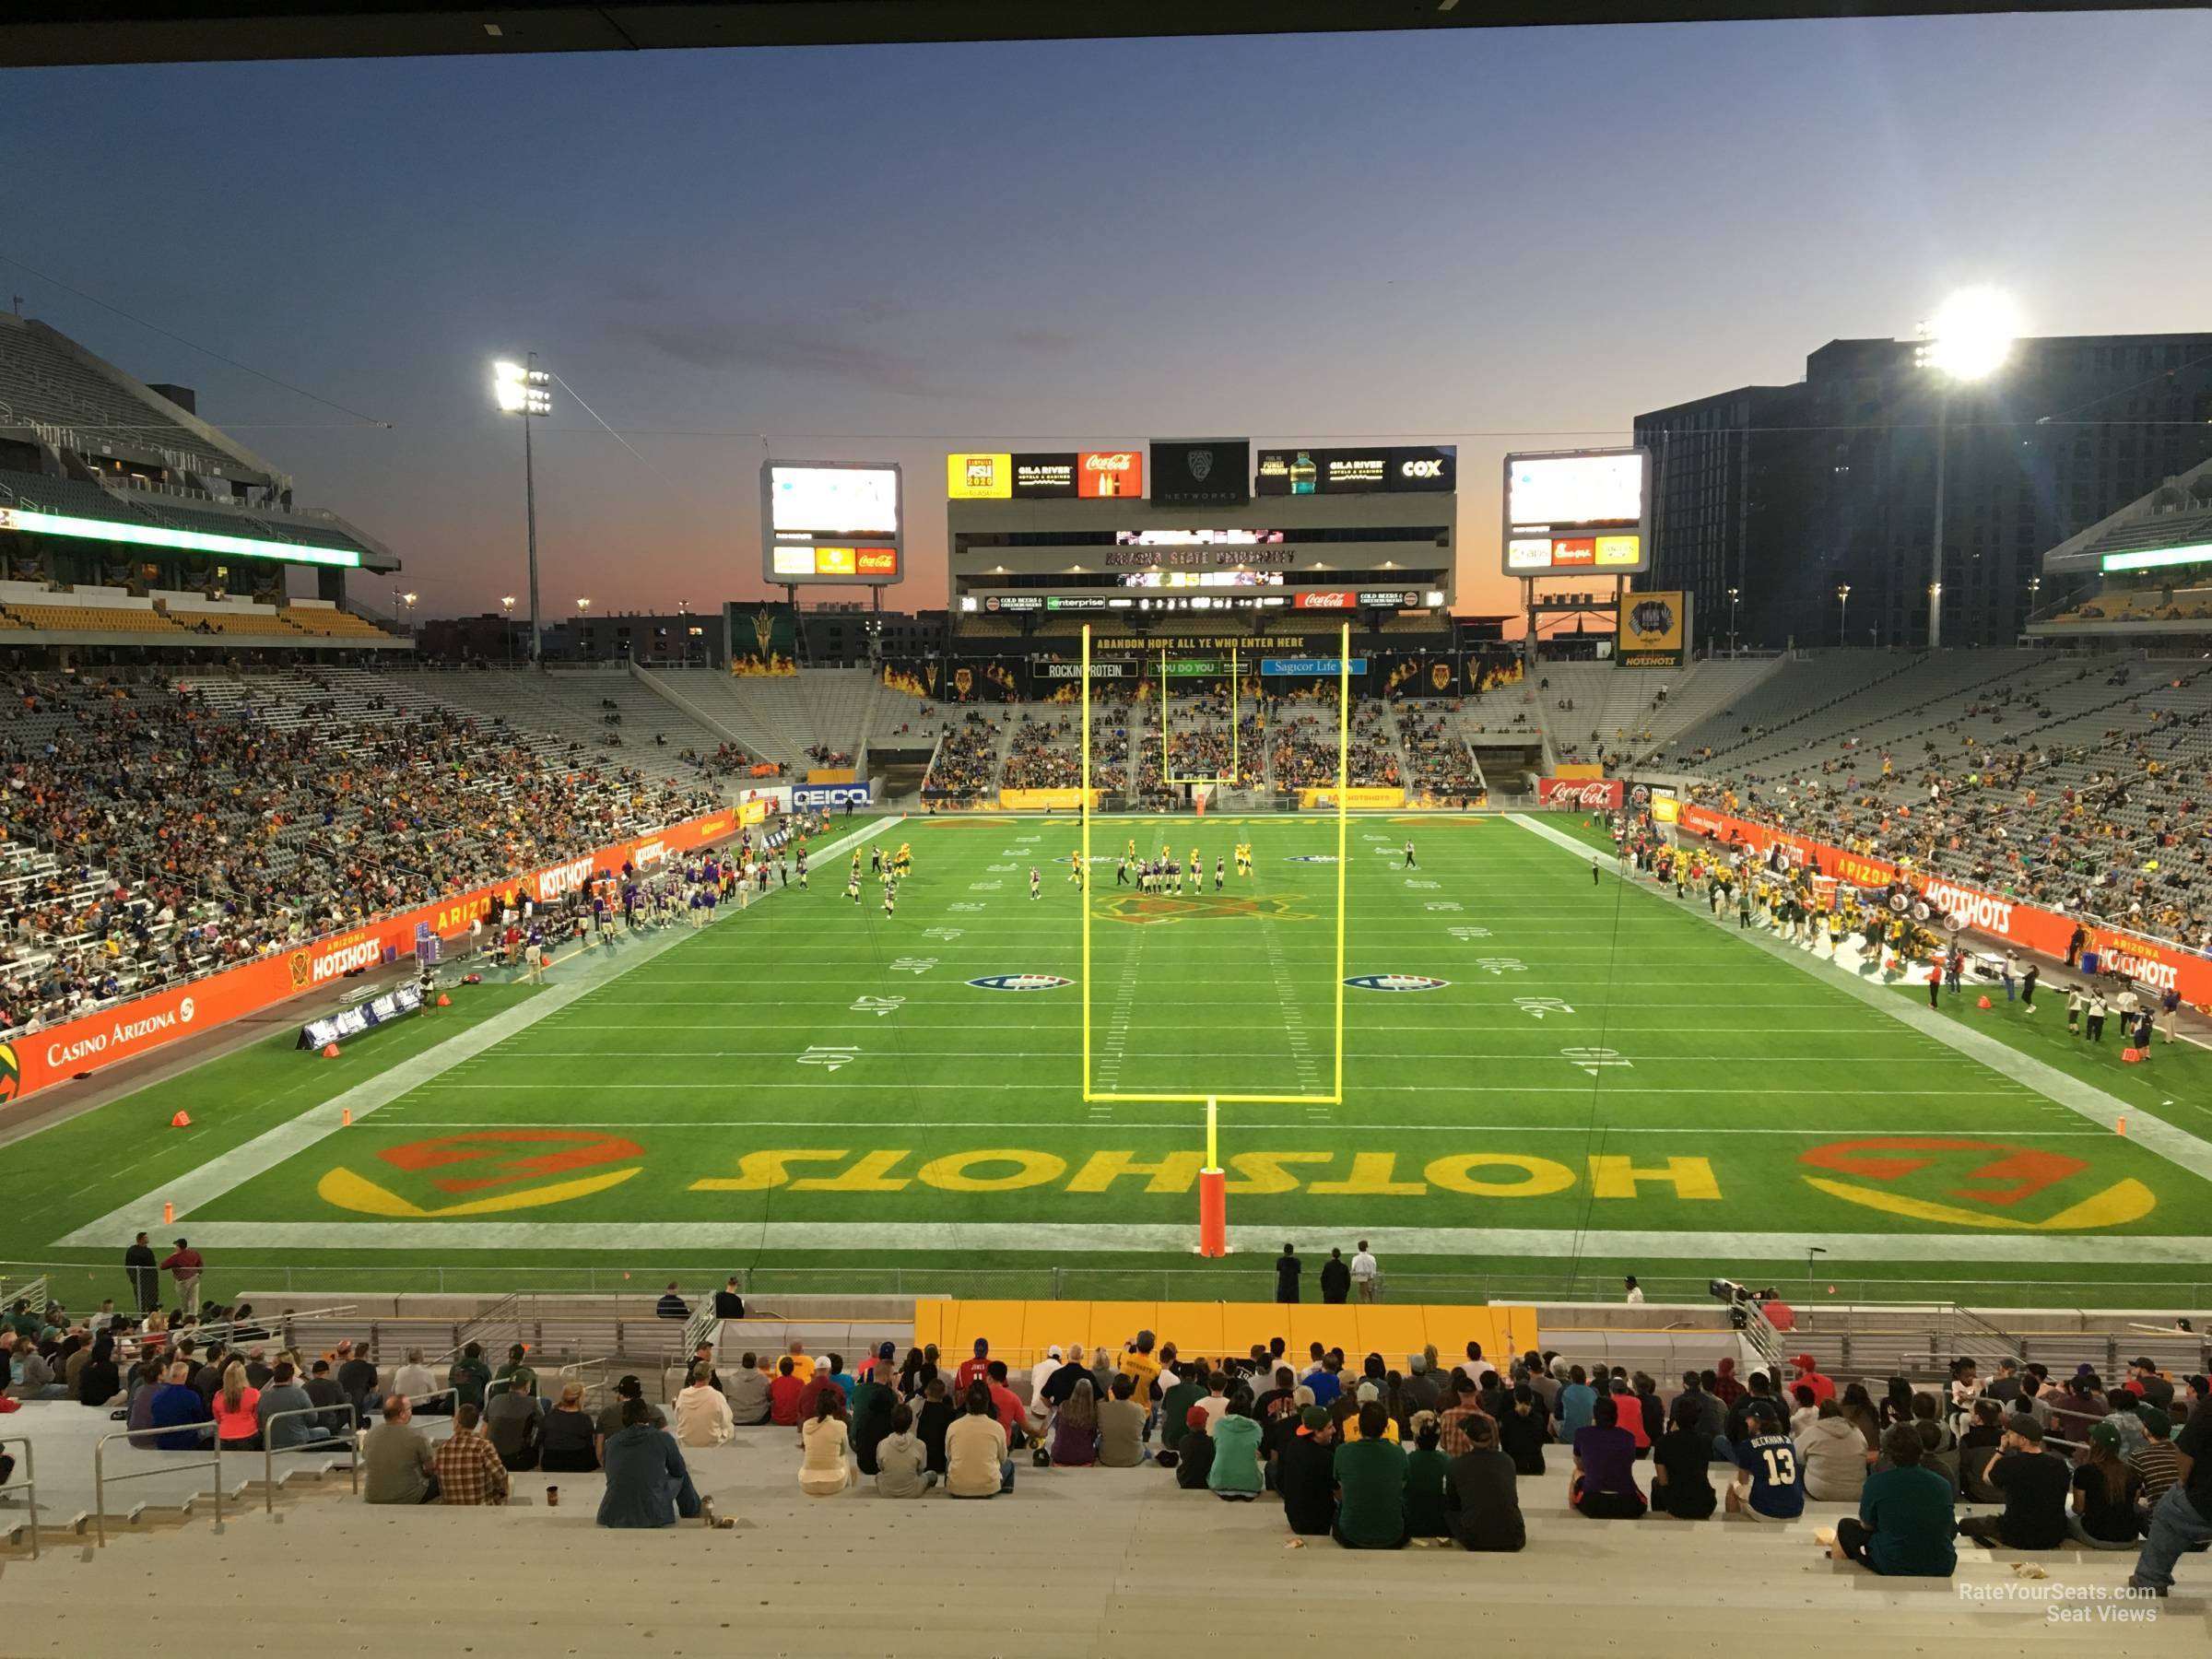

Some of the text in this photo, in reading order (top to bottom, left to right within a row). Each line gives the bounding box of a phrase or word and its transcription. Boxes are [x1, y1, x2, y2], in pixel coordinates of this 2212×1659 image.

[1086, 454, 1133, 470] Coca-Cola
[1330, 461, 1353, 469] GILA
[1402, 459, 1443, 477] COX
[968, 465, 992, 477] ASU
[1018, 465, 1070, 475] GILA RIVER
[968, 477, 993, 486] 2020
[859, 555, 893, 568] Coca-Cola
[1170, 552, 1209, 565] STATE
[1052, 599, 1104, 608] enterprise
[1305, 593, 1346, 607] Coca-Cola
[1097, 637, 1304, 649] ABANDON HOPE ALL YE WHO ENTER HERE
[1156, 663, 1215, 673] YOU DO YOU
[1275, 660, 1336, 674] Sagicor Life
[1626, 657, 1676, 666] HOTSHOTS
[1087, 664, 1123, 677] ROTEIN
[794, 788, 869, 806] GEICO
[1551, 782, 1614, 805] Coca-Cola
[1039, 818, 1364, 827] HOTSHOTS
[1837, 858, 1892, 886] ARIZON
[437, 888, 514, 931] ARIZOA
[1924, 880, 2013, 935] HOTSHOTS
[326, 932, 367, 952] ARIZONA
[2112, 937, 2160, 959] ARIZONA
[312, 937, 382, 982] HOTSHOTS
[2096, 944, 2179, 990] HOTSHOTS
[47, 1012, 177, 1068] CASINO ARIZONA
[687, 1148, 1723, 1200] HOTSHOTS
[1750, 1435, 1785, 1449] BECKHAM
[1763, 1448, 1796, 1486] 13
